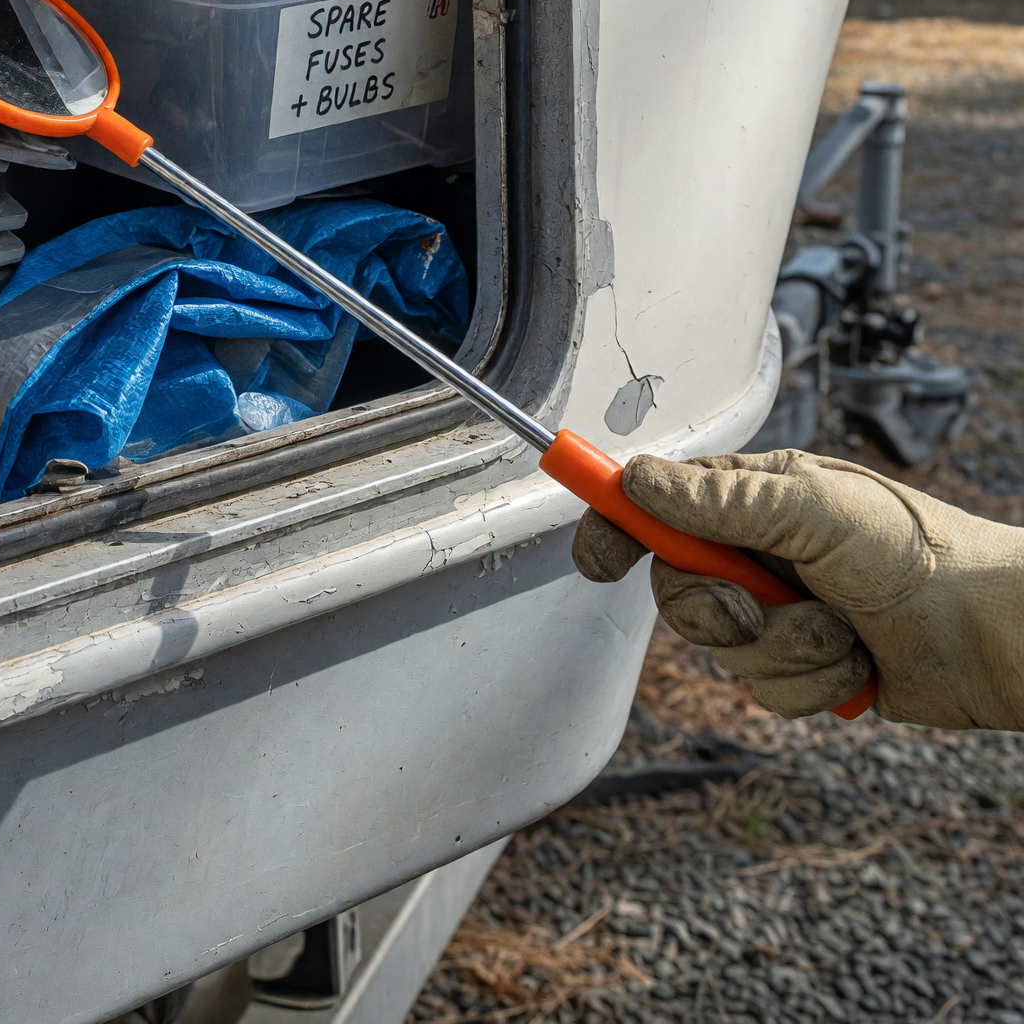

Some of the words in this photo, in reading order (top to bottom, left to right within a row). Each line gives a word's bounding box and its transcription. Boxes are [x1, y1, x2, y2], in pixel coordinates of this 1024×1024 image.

[305, 37, 386, 82] FUSES
[290, 94, 308, 118] +
[316, 72, 396, 116] BULBS
